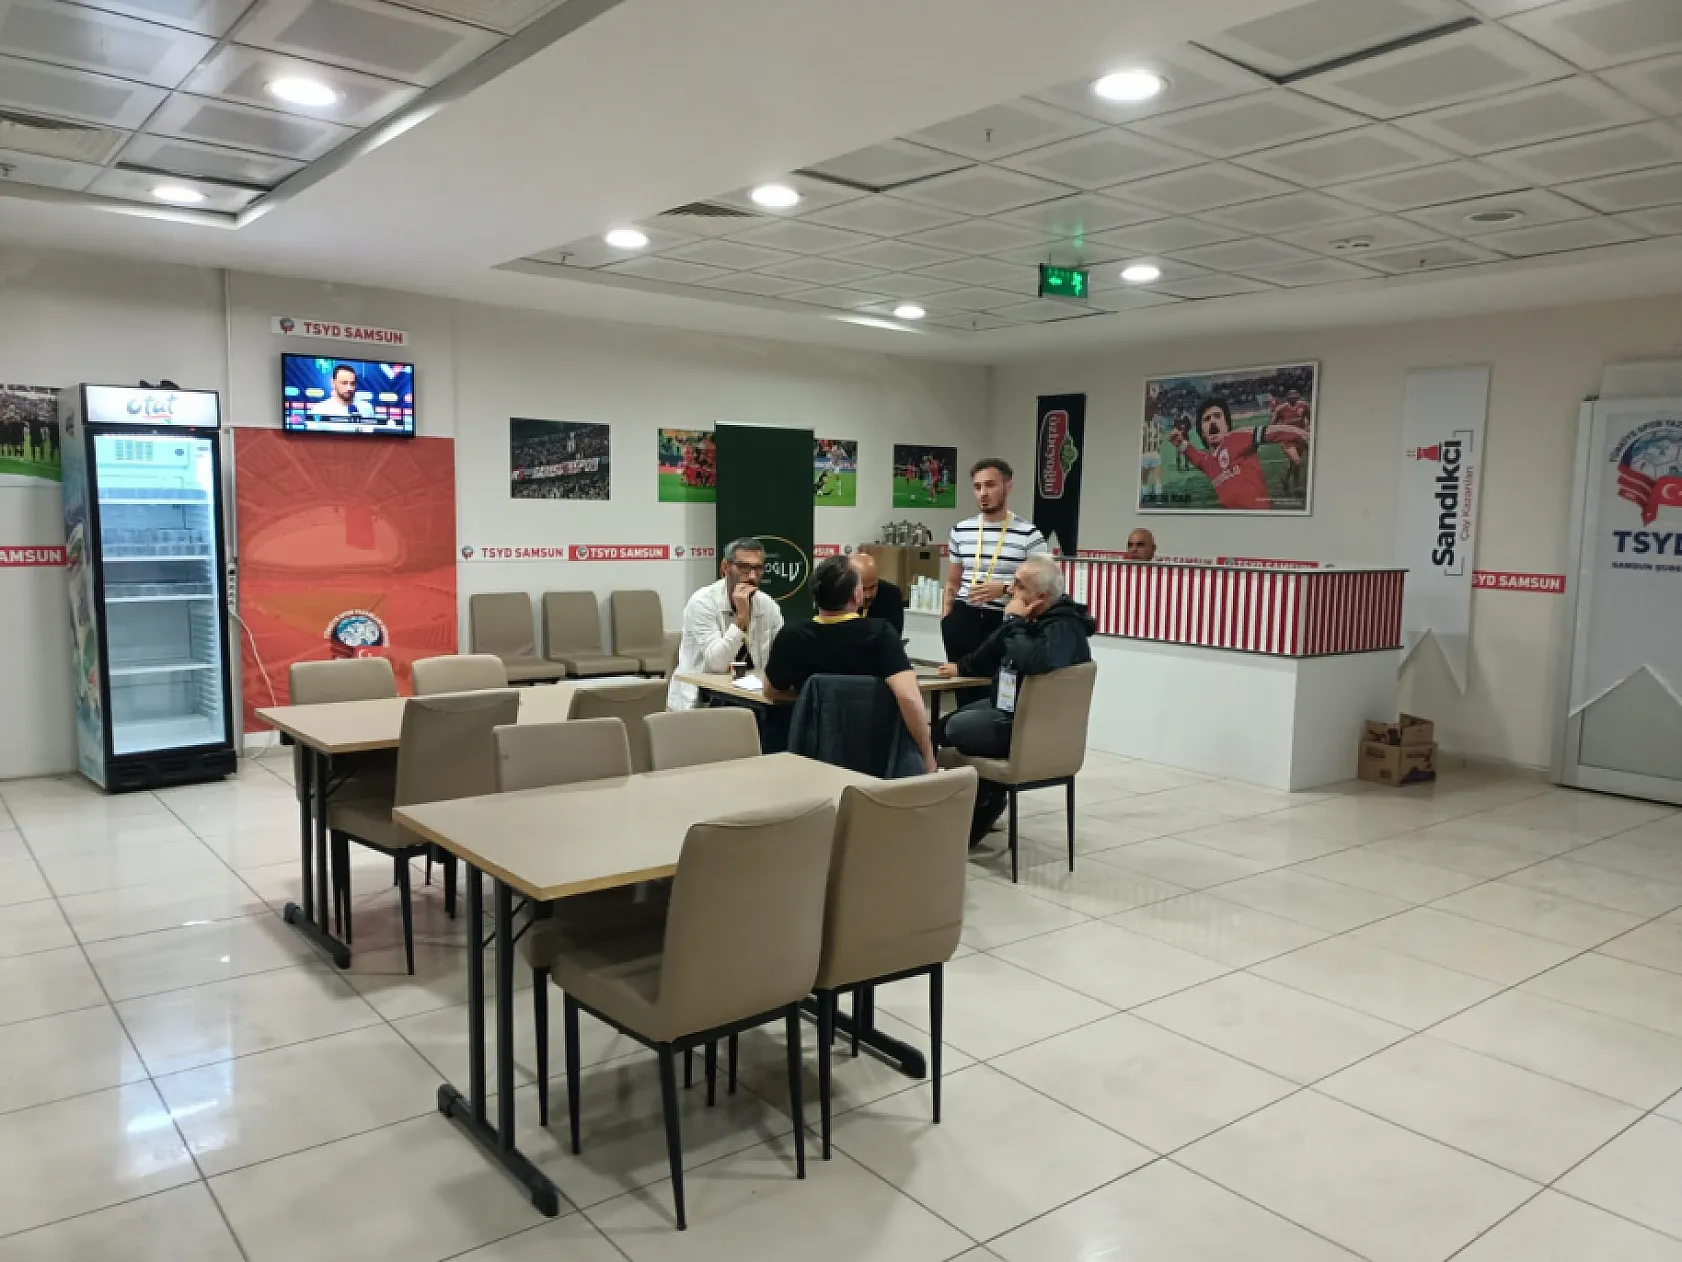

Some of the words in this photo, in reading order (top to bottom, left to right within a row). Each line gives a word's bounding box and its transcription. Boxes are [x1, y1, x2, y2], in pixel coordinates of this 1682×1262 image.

[303, 321, 341, 338] TSYD
[344, 326, 404, 345] SAMSUN
[481, 546, 512, 558] TSYD
[514, 546, 564, 558] SAMSUN
[589, 546, 617, 558] TSYD
[619, 546, 664, 558] SAMSUN
[1499, 575, 1560, 590] SAMSUN
